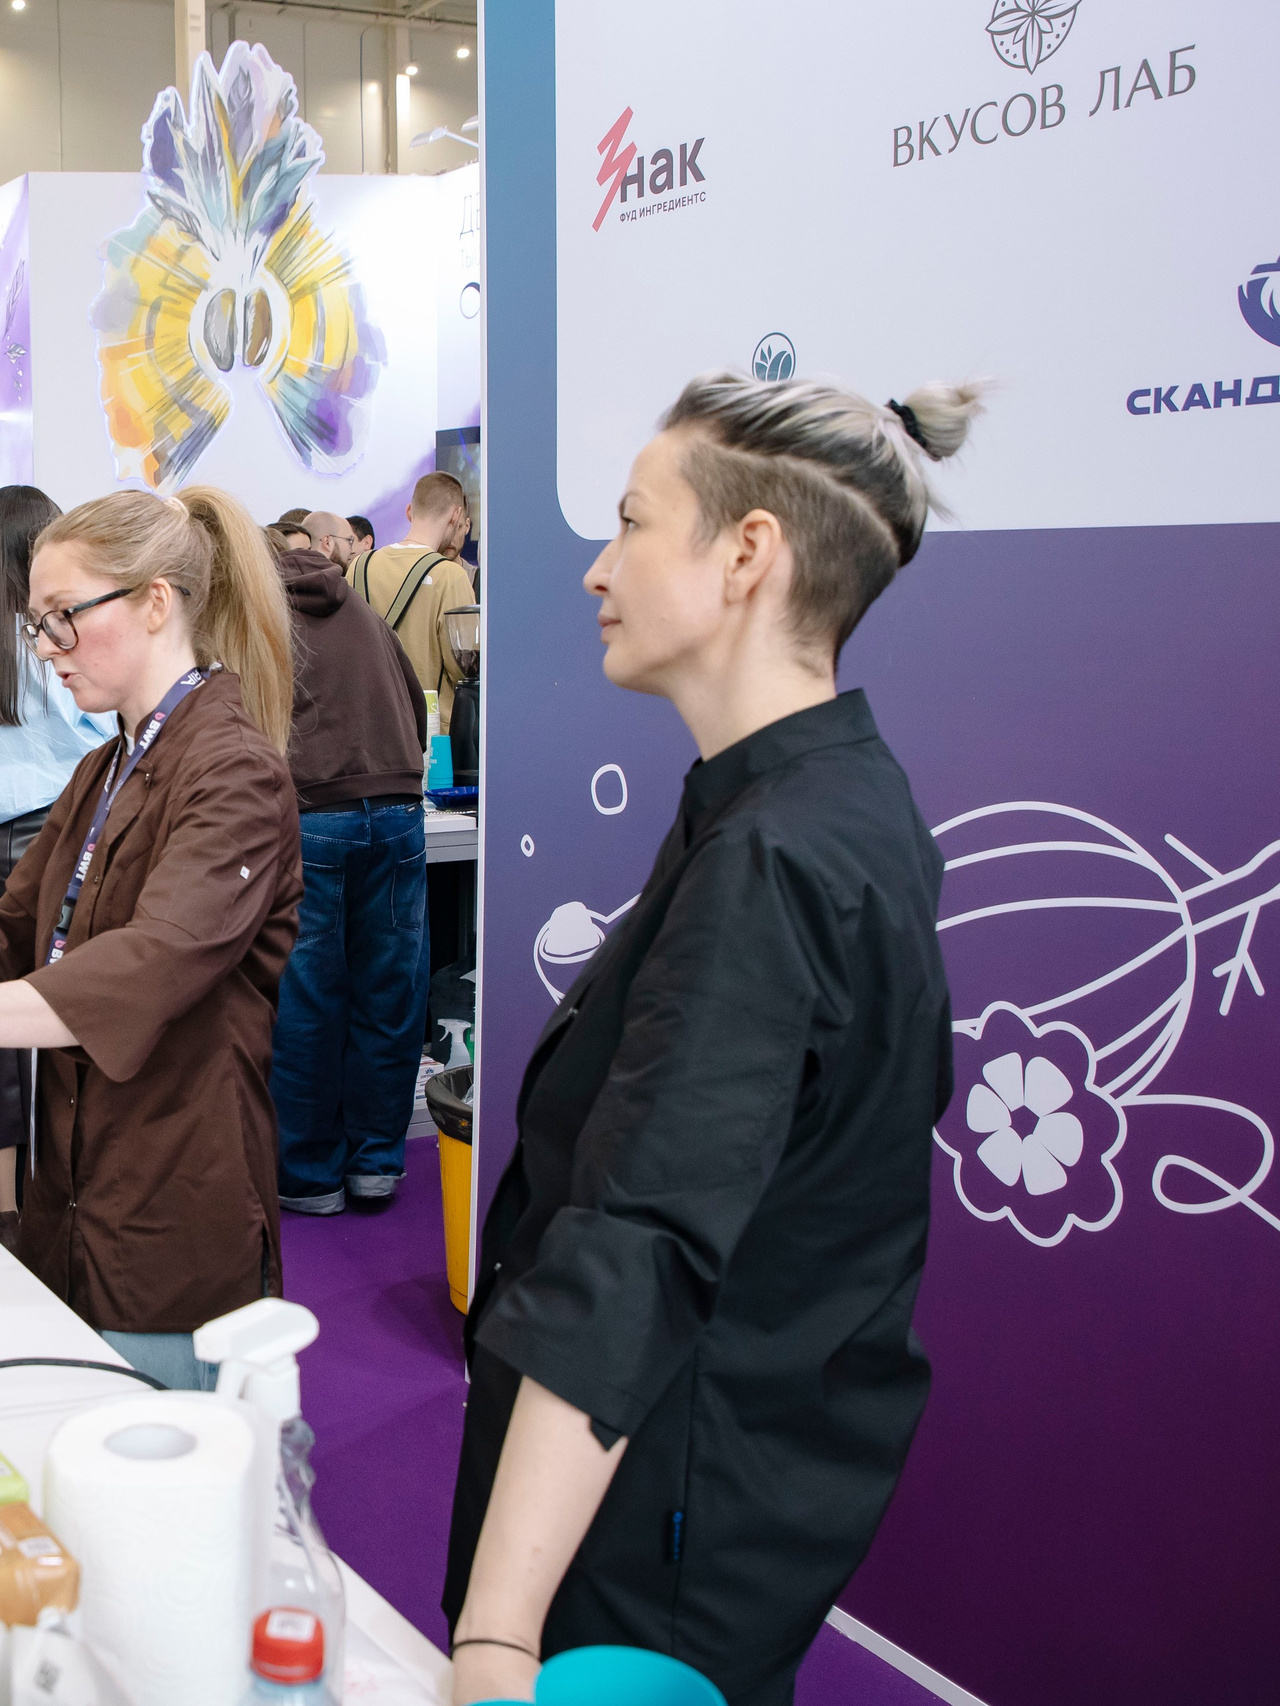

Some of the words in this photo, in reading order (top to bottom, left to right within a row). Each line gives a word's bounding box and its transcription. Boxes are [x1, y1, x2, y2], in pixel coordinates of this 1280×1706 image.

[892, 83, 1066, 168] ВКУСОВ
[1088, 43, 1197, 118] ЛАБ
[619, 209, 637, 222] ФУД
[639, 191, 707, 218] ИНГРЕДИЕНТС
[139, 719, 162, 750] BWT
[75, 851, 94, 882] BWT
